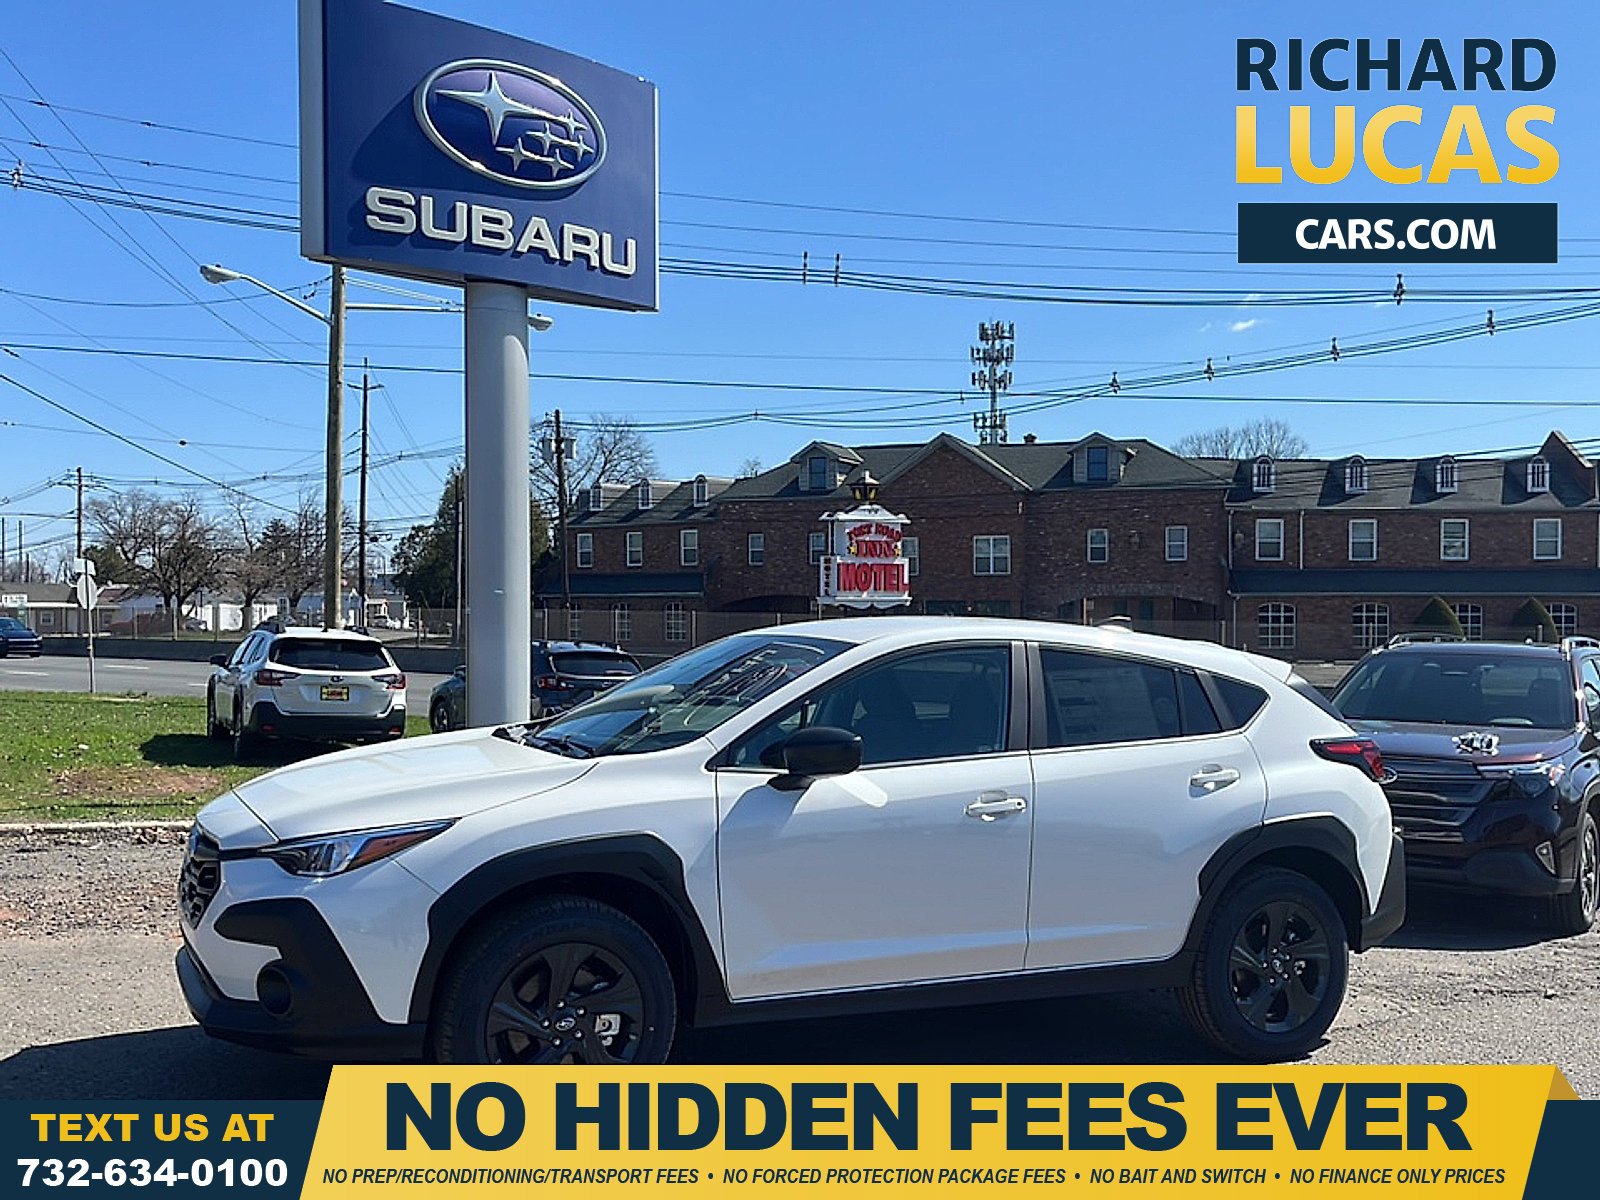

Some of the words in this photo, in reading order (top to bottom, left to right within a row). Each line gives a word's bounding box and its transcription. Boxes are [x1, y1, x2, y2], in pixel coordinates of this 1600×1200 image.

[365, 186, 637, 276] SUBARU
[856, 540, 895, 557] INN
[837, 562, 911, 593] MOTEL
